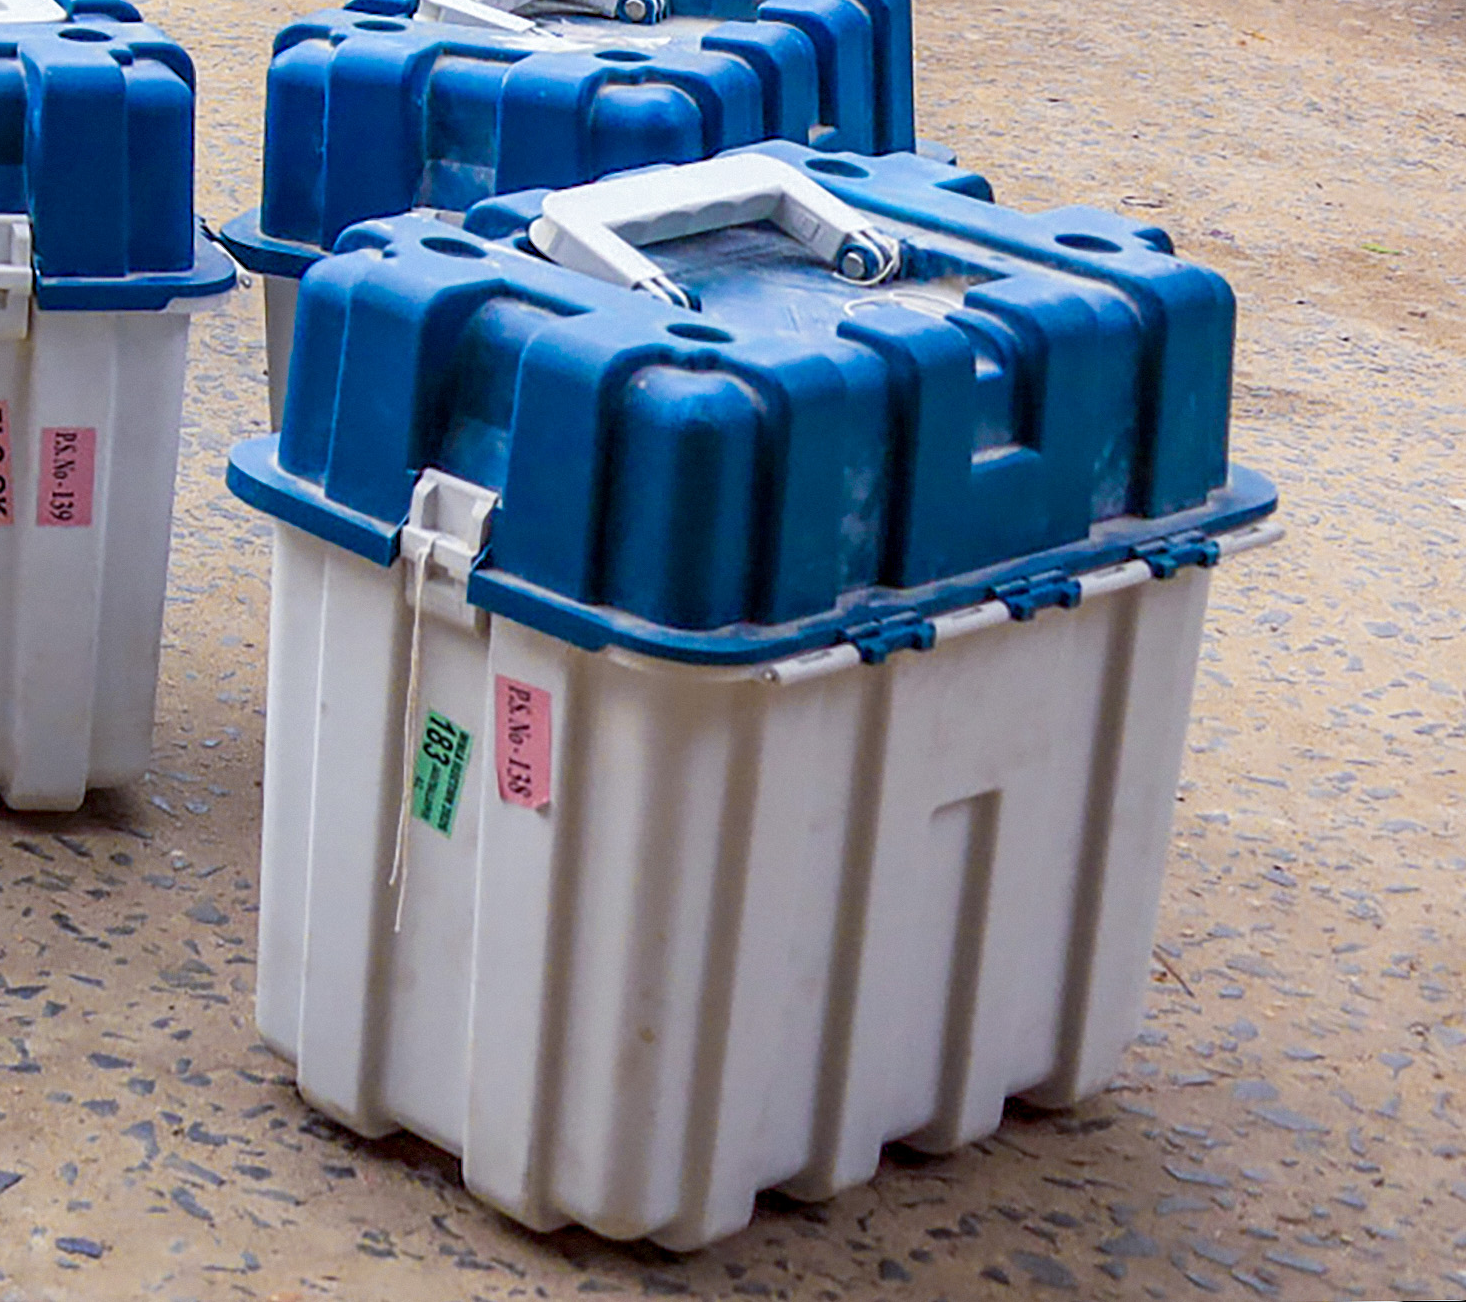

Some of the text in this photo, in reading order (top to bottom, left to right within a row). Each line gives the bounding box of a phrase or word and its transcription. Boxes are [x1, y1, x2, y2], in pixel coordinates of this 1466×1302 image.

[49, 492, 75, 522] 139
[422, 715, 457, 767] 183
[506, 756, 533, 798] 138
